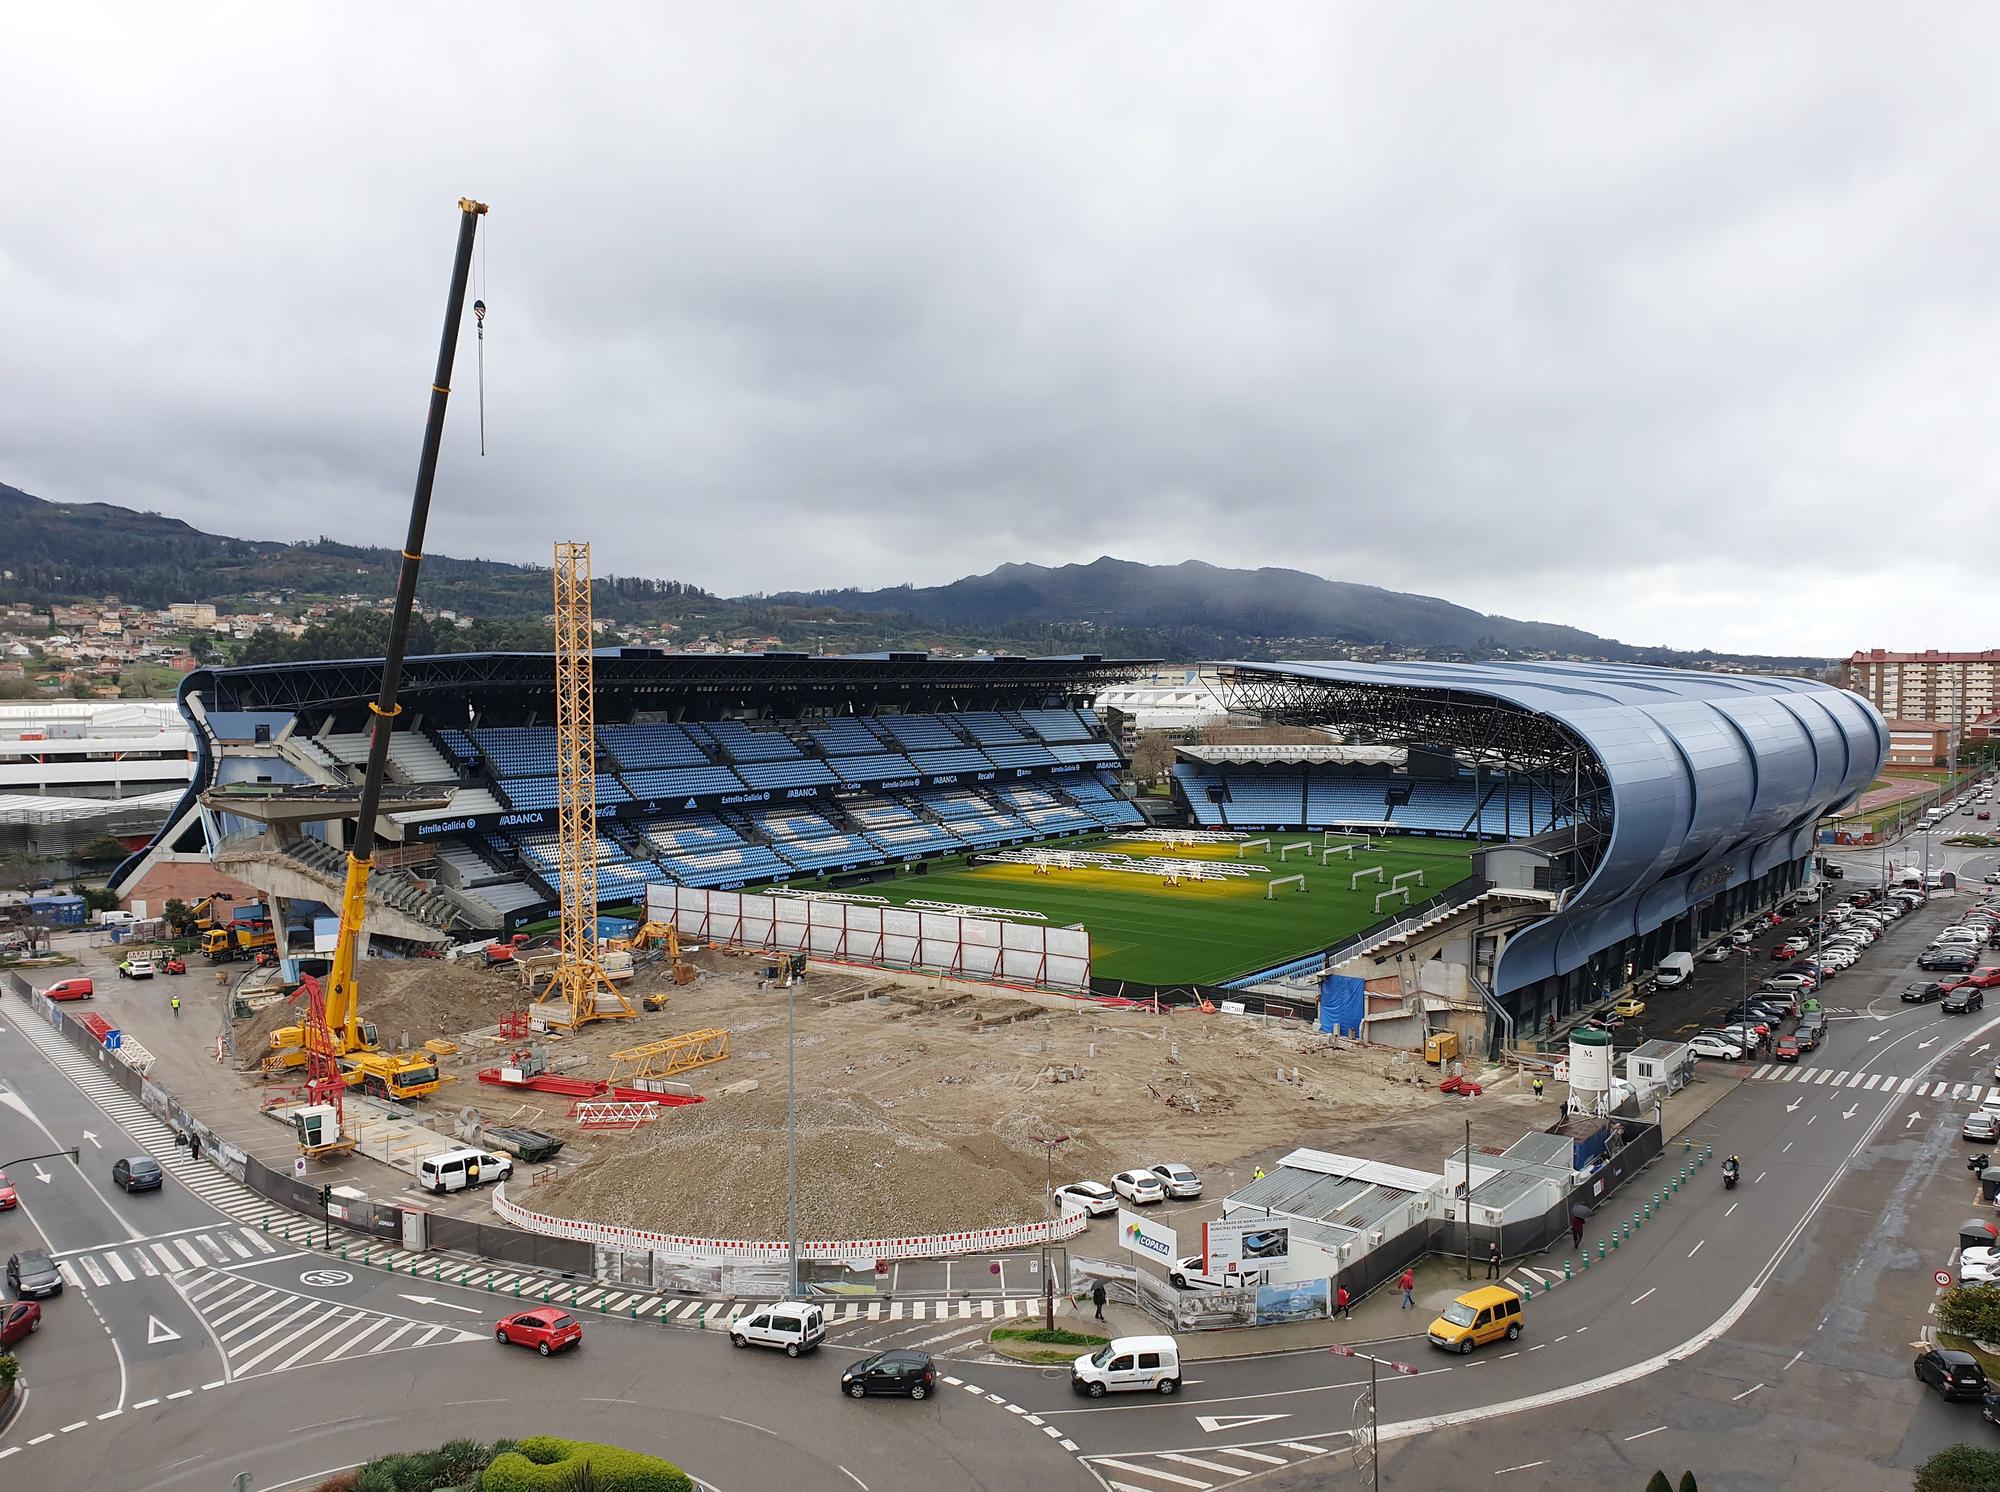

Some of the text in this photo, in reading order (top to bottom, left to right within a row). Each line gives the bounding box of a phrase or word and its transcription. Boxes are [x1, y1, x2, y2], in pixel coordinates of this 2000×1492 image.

[934, 775, 957, 784] ABANCA
[789, 788, 817, 798] ABANCA
[721, 794, 763, 804] Estrella Galicia
[503, 813, 543, 824] ABANCA
[418, 821, 466, 835] Estrella Galicia
[720, 881, 745, 891] ABANCA
[1140, 1236, 1168, 1255] COPASA
[306, 1272, 347, 1285] 30
